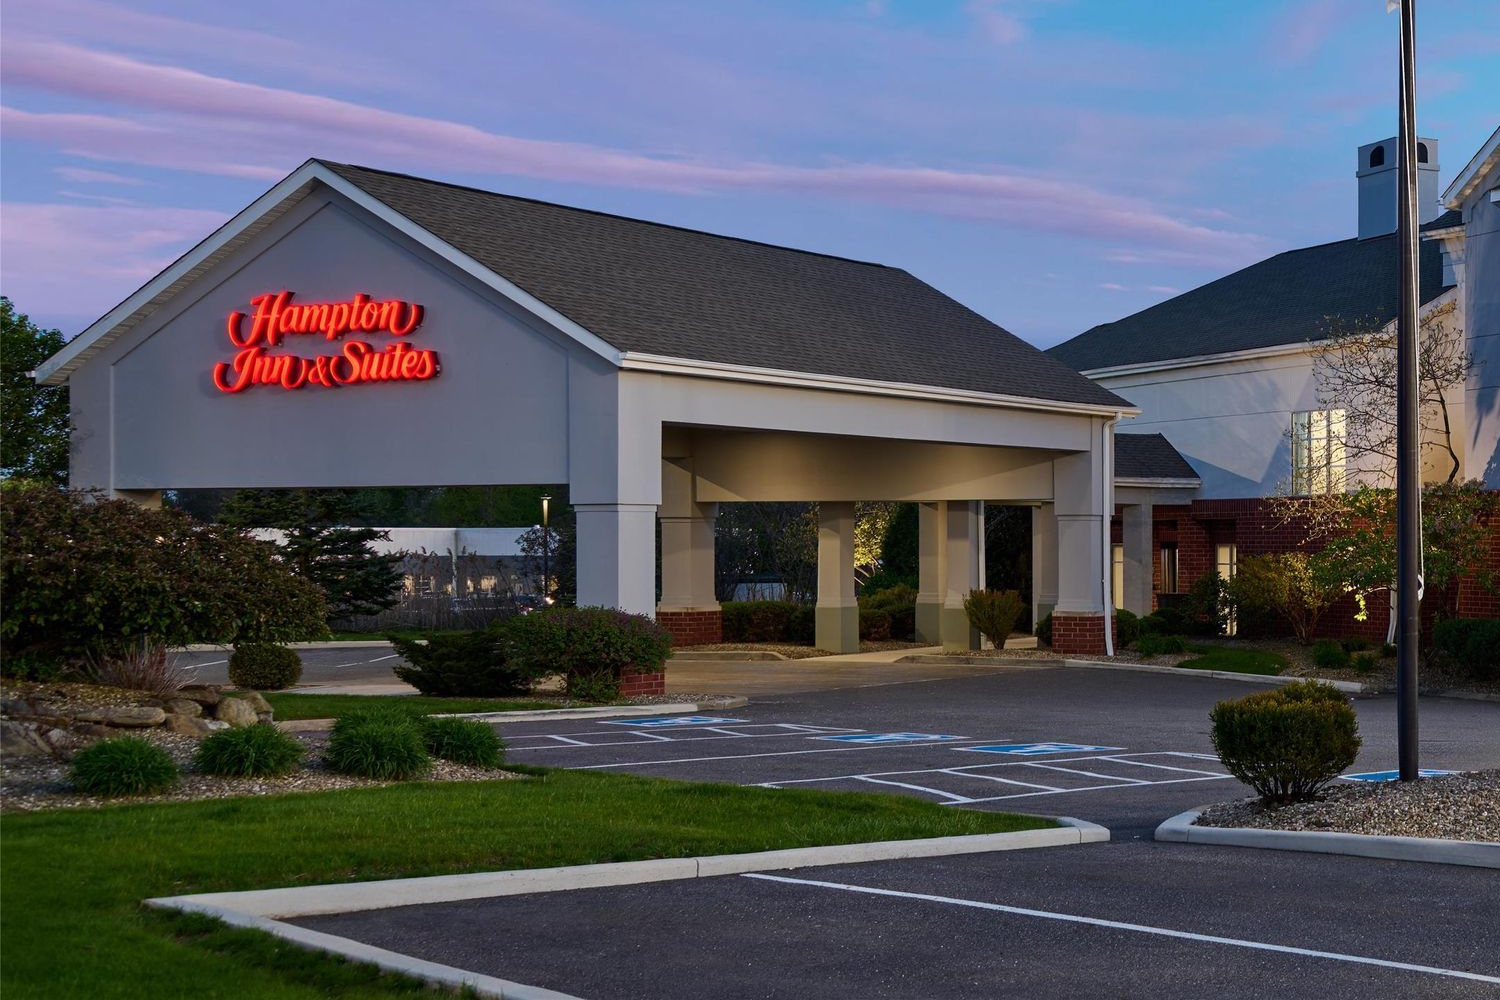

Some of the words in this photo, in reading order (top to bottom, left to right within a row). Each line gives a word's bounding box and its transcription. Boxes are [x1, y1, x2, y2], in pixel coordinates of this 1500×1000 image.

[228, 291, 425, 347] Hampton
[213, 347, 312, 393] Inn
[307, 355, 341, 388] &
[329, 341, 441, 384] Suites
